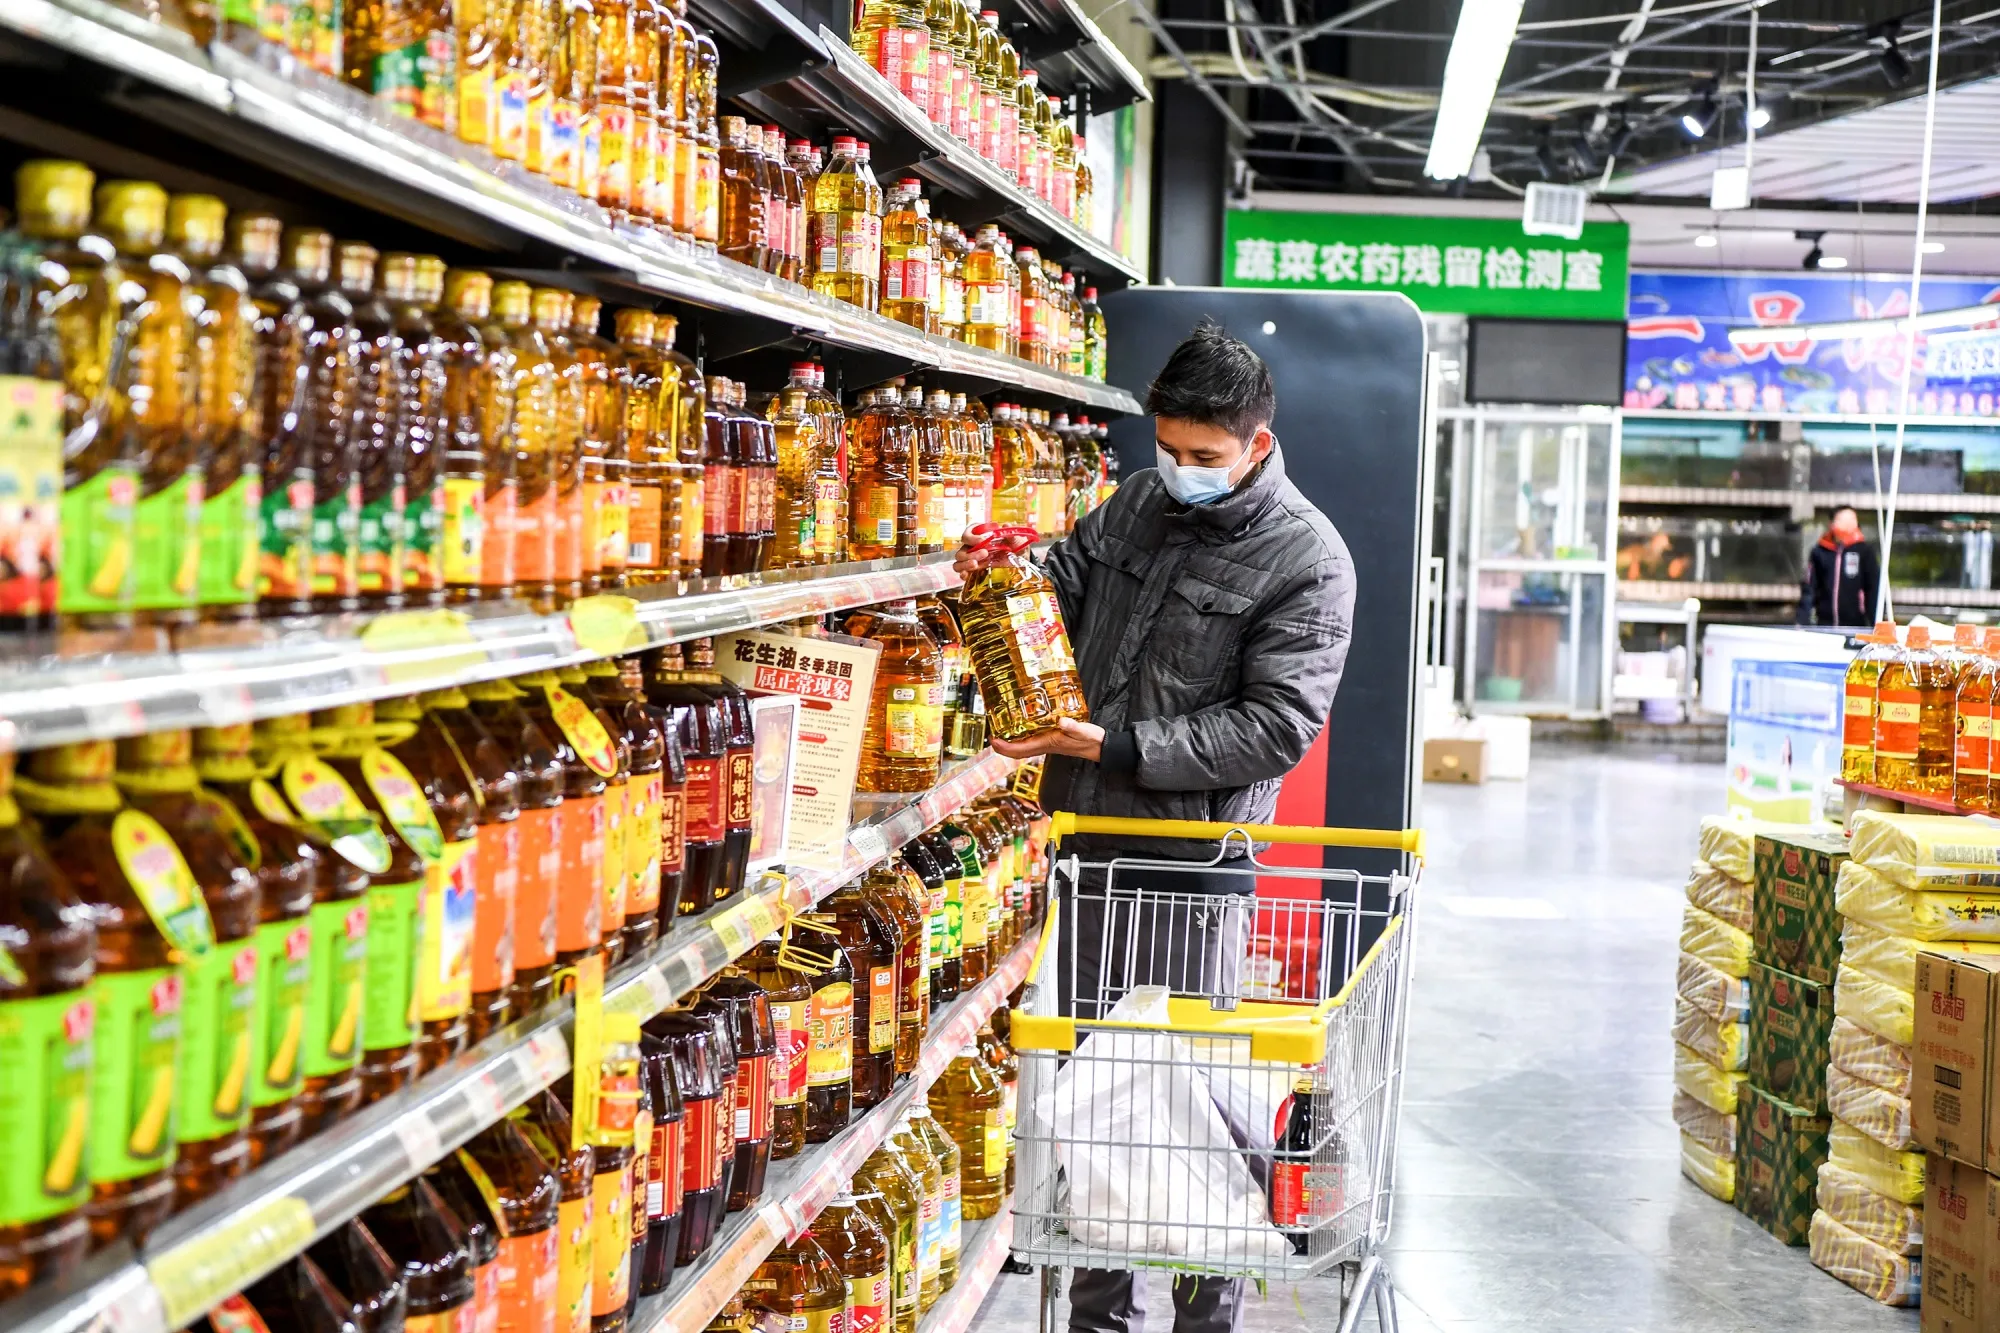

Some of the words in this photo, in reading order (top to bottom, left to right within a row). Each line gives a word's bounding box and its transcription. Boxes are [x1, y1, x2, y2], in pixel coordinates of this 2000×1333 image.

[1234, 238, 1603, 291] 蔬菜农药残留检测室
[735, 639, 797, 670] 花生油
[799, 656, 853, 679] 冬季凝固
[757, 667, 850, 701] 属正常现象
[732, 759, 747, 819] 胡姬花
